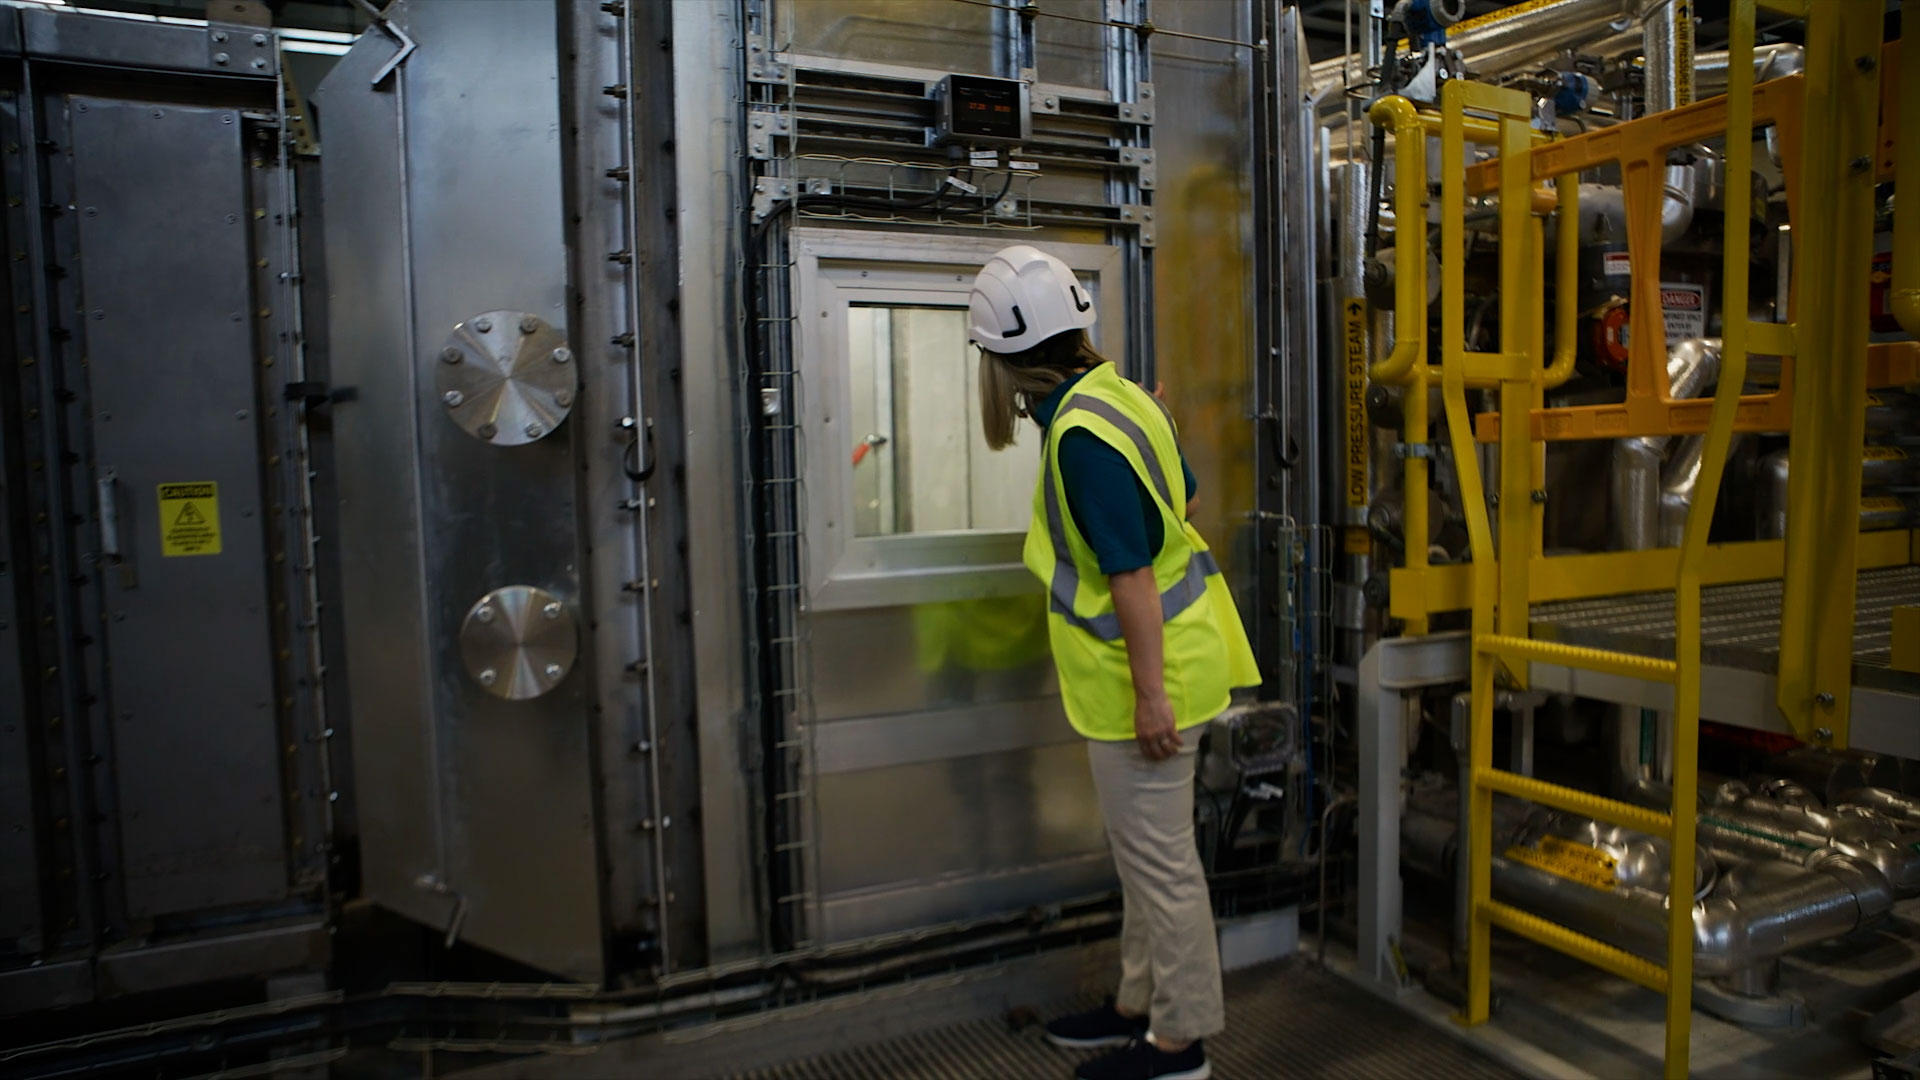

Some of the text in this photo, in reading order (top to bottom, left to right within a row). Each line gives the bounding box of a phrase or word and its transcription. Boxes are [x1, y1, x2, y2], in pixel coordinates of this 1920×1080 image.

[1679, 42, 1689, 85] PRESSURE
[1662, 293, 1696, 306] DANGER
[1348, 321, 1365, 506] LOW PRESSURE STEAM
